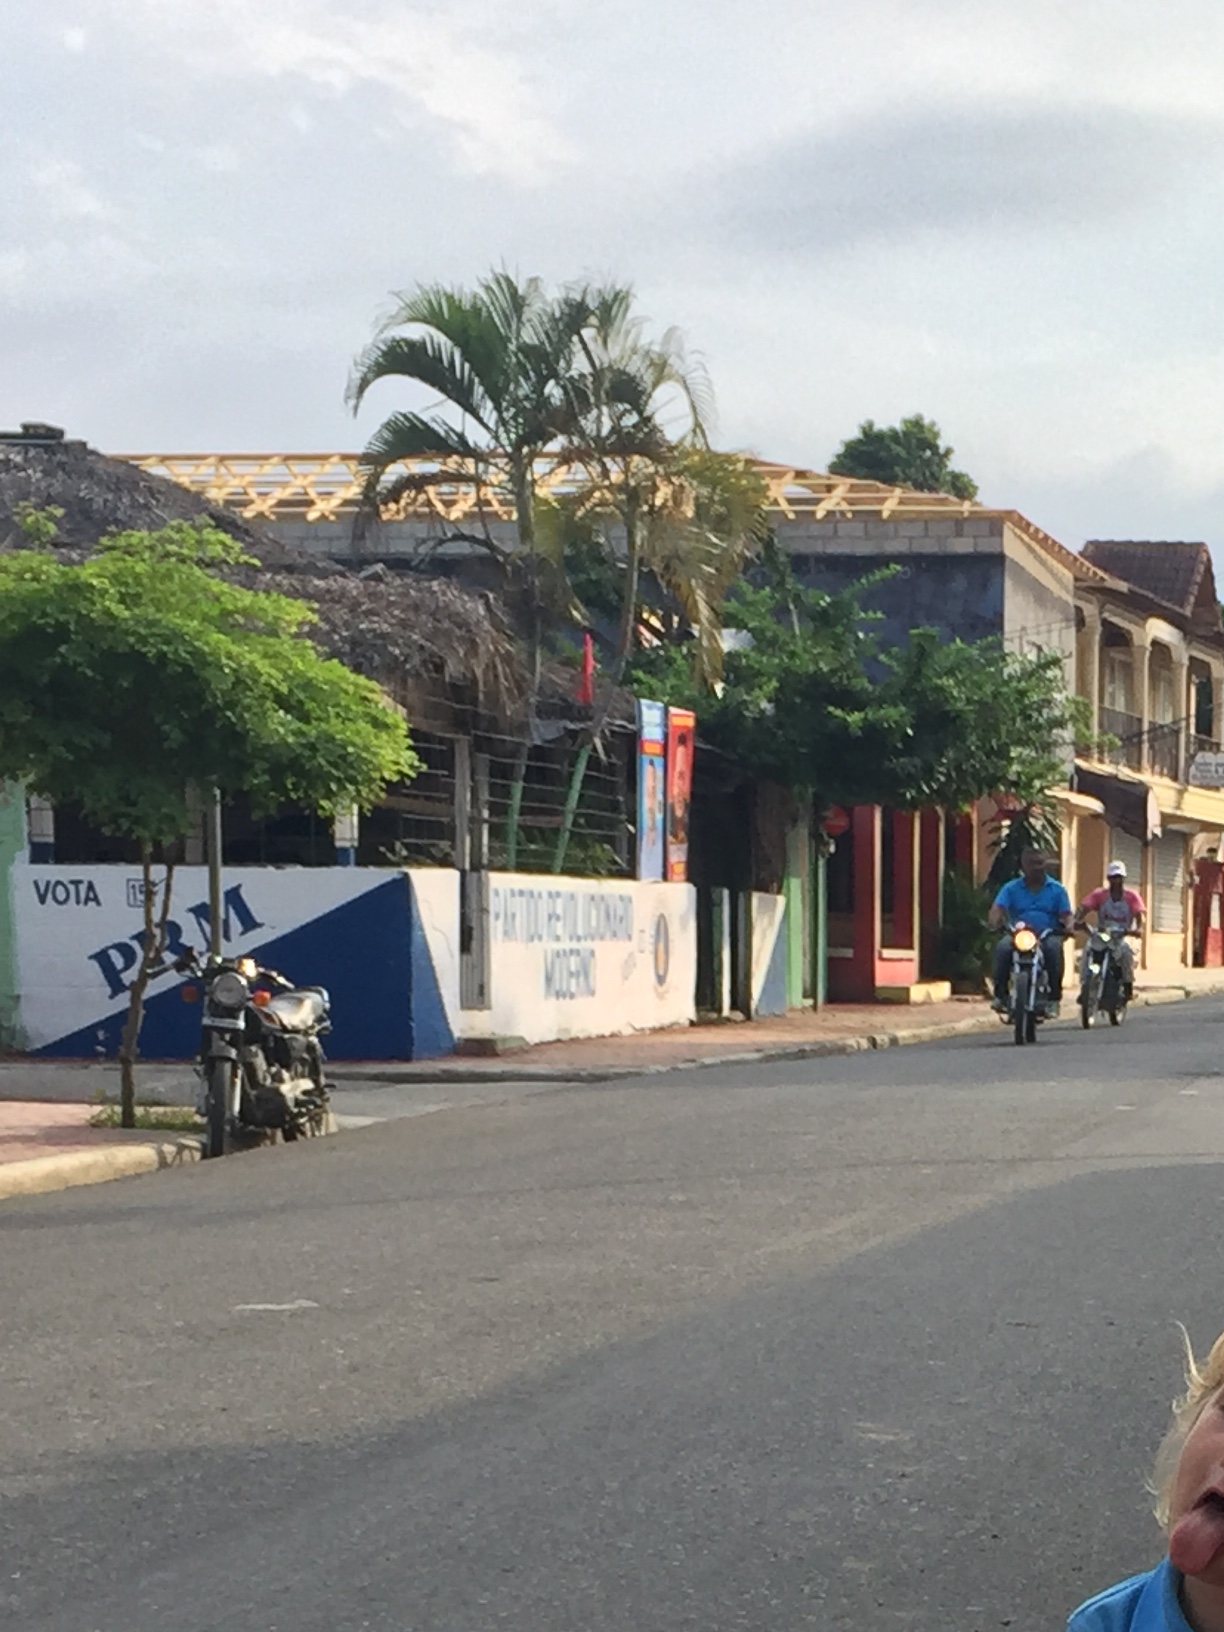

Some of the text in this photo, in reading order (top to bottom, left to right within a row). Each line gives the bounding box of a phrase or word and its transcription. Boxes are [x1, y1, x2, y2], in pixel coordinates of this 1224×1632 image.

[33, 879, 102, 907] VOTA
[492, 887, 544, 944] PARTIDO
[546, 889, 633, 943] REVOLUCIONARIO
[88, 884, 265, 1000] PRM
[544, 948, 596, 1000] MODERNO
